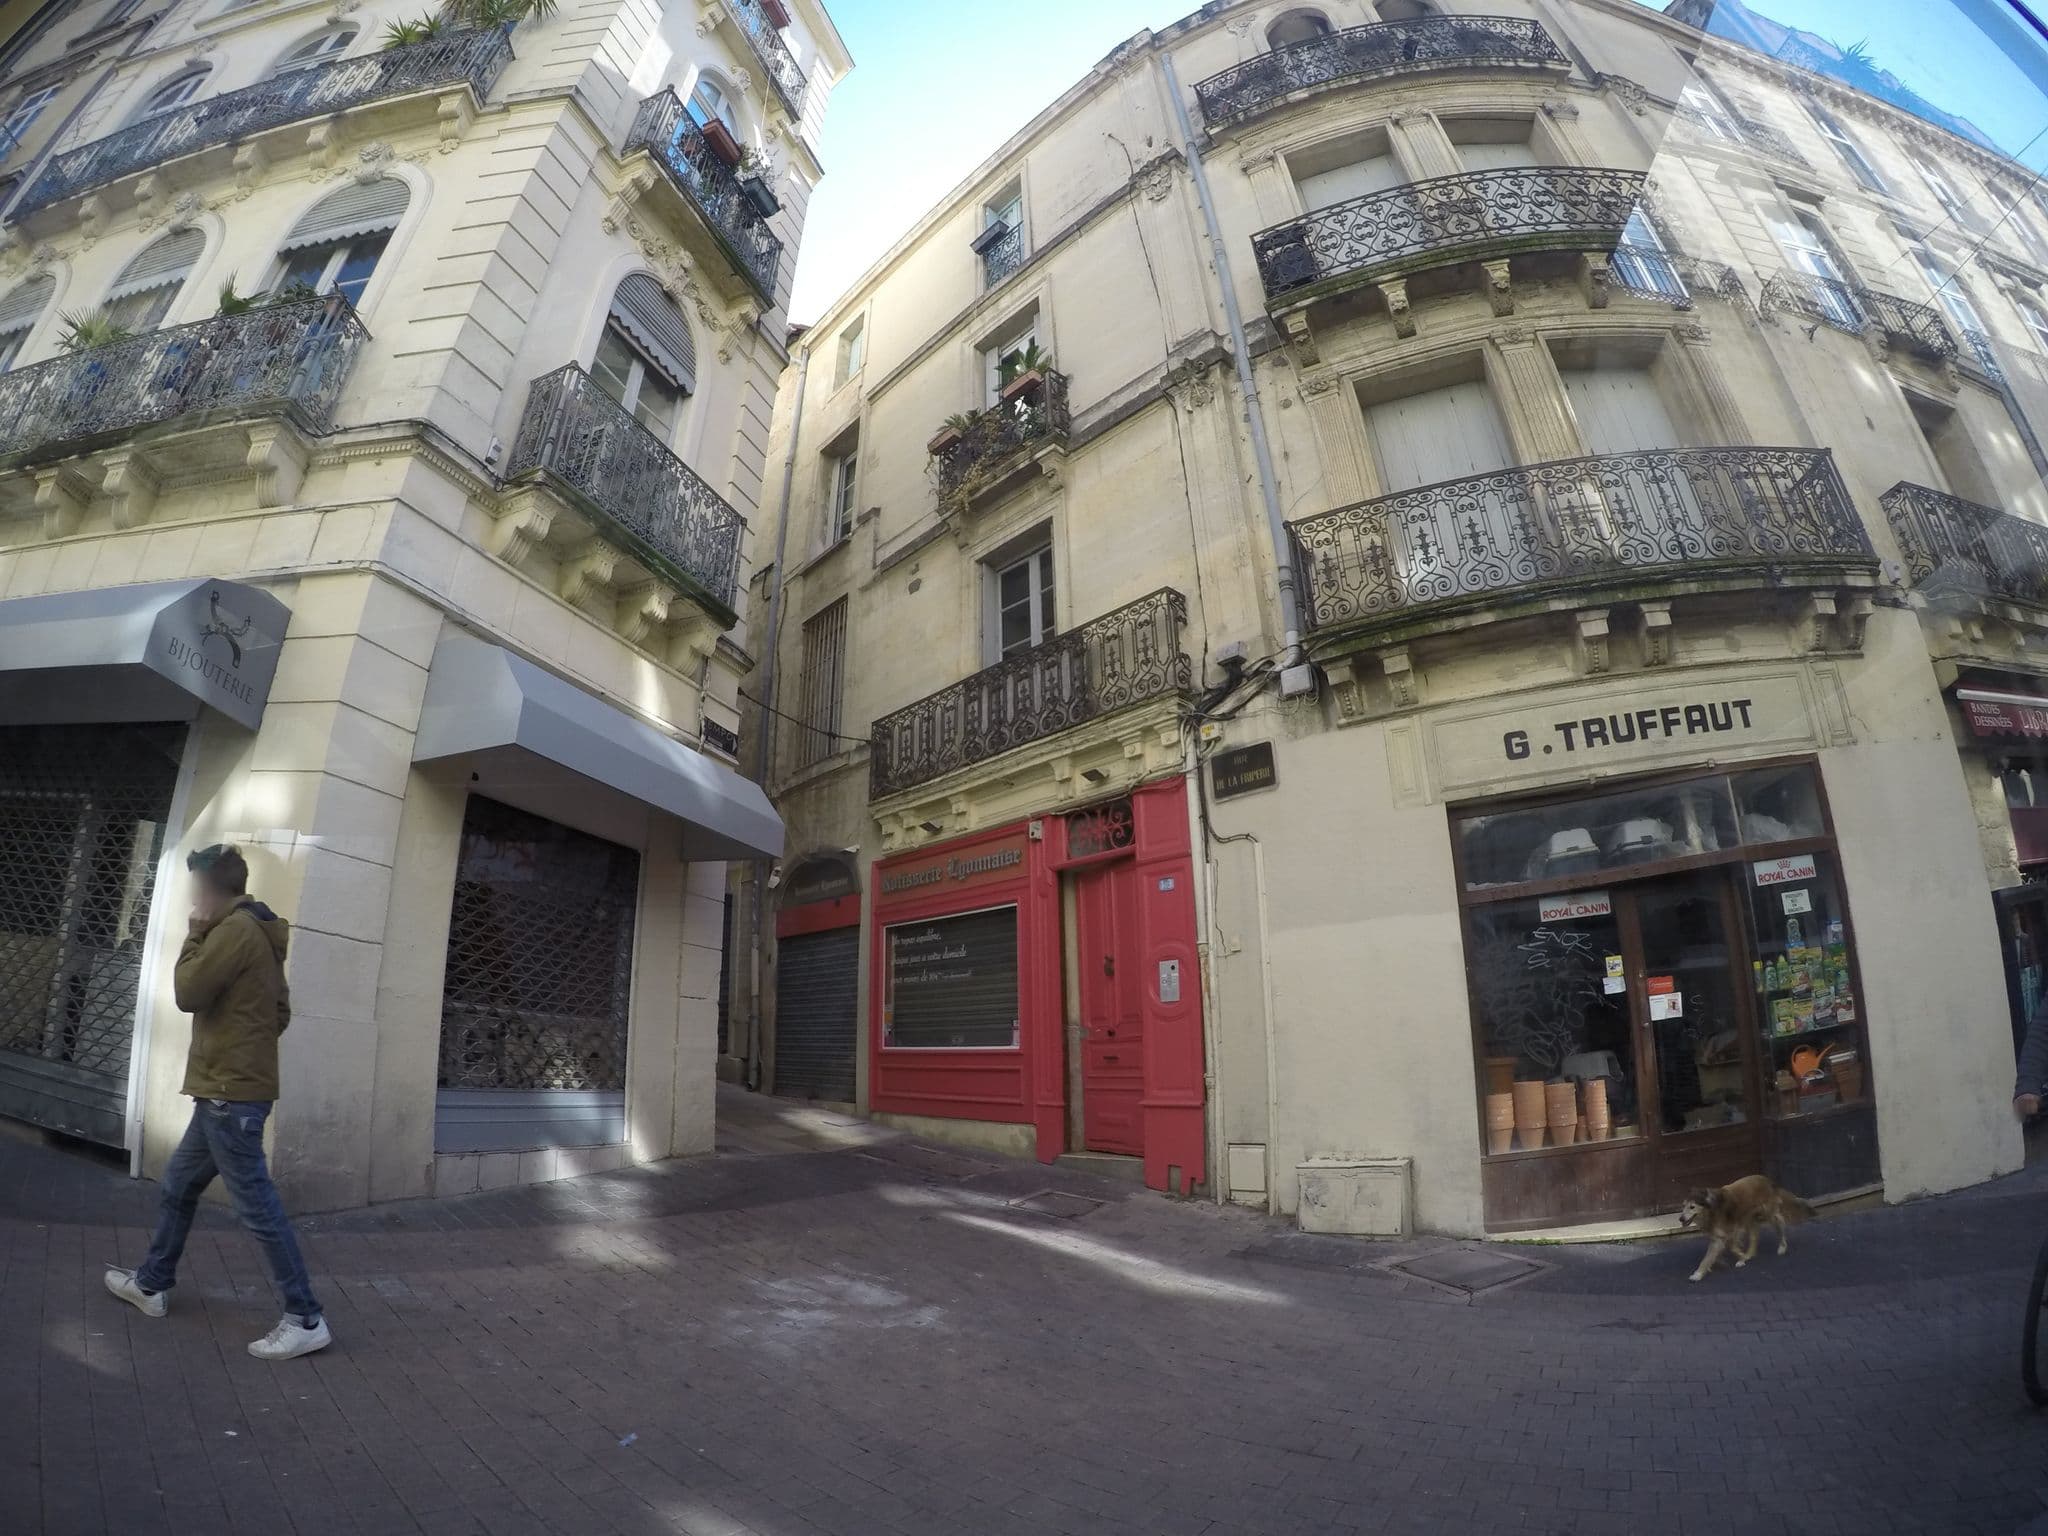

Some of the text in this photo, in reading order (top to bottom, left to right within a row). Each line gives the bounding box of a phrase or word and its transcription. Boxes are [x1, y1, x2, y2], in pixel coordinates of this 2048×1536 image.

[168, 637, 255, 705] BIJOUTERIE
[1969, 702, 2001, 715] BANDES
[1757, 866, 1815, 884] ROYAL CANIN
[1542, 902, 1609, 920] ROYAL CANIN
